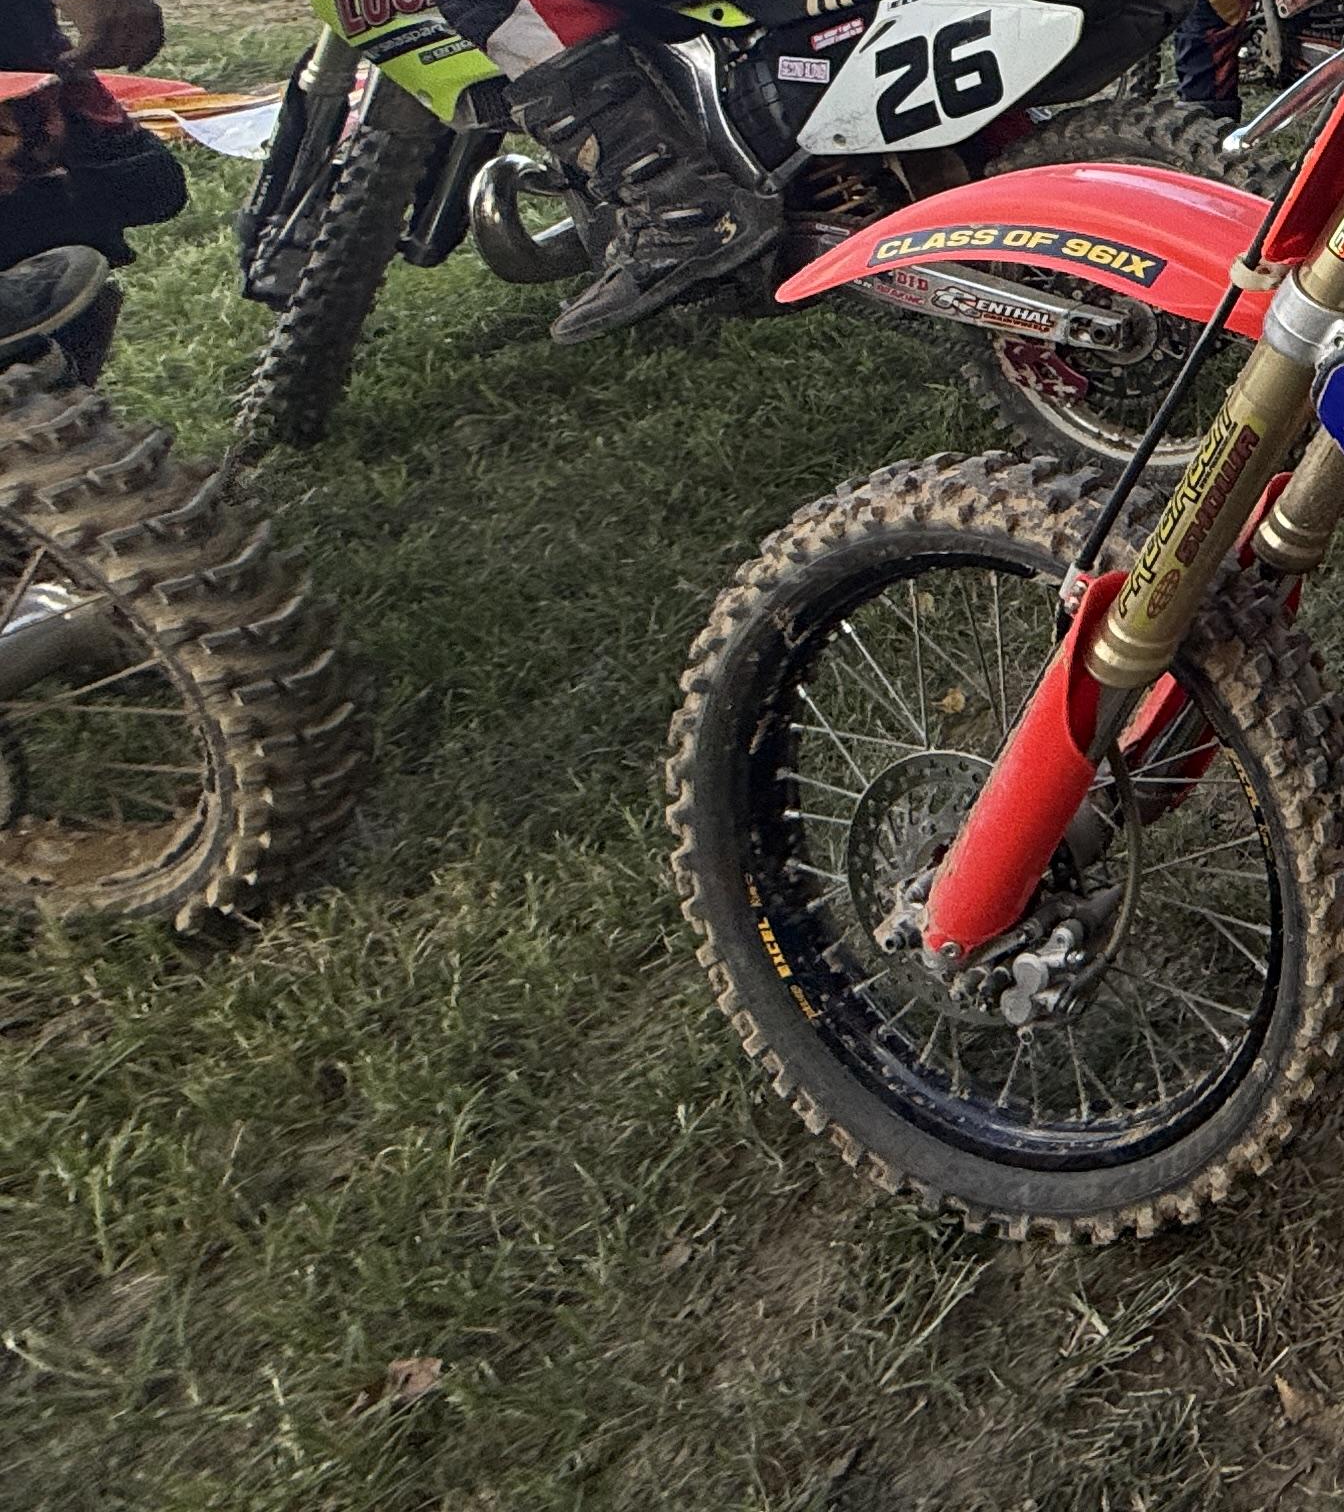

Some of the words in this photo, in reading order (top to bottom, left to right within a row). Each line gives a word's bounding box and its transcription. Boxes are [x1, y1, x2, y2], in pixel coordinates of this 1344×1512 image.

[875, 9, 1004, 145] 26
[876, 229, 1000, 260] CLASS
[1002, 228, 1060, 249] OF
[757, 916, 794, 979] EXCEL
